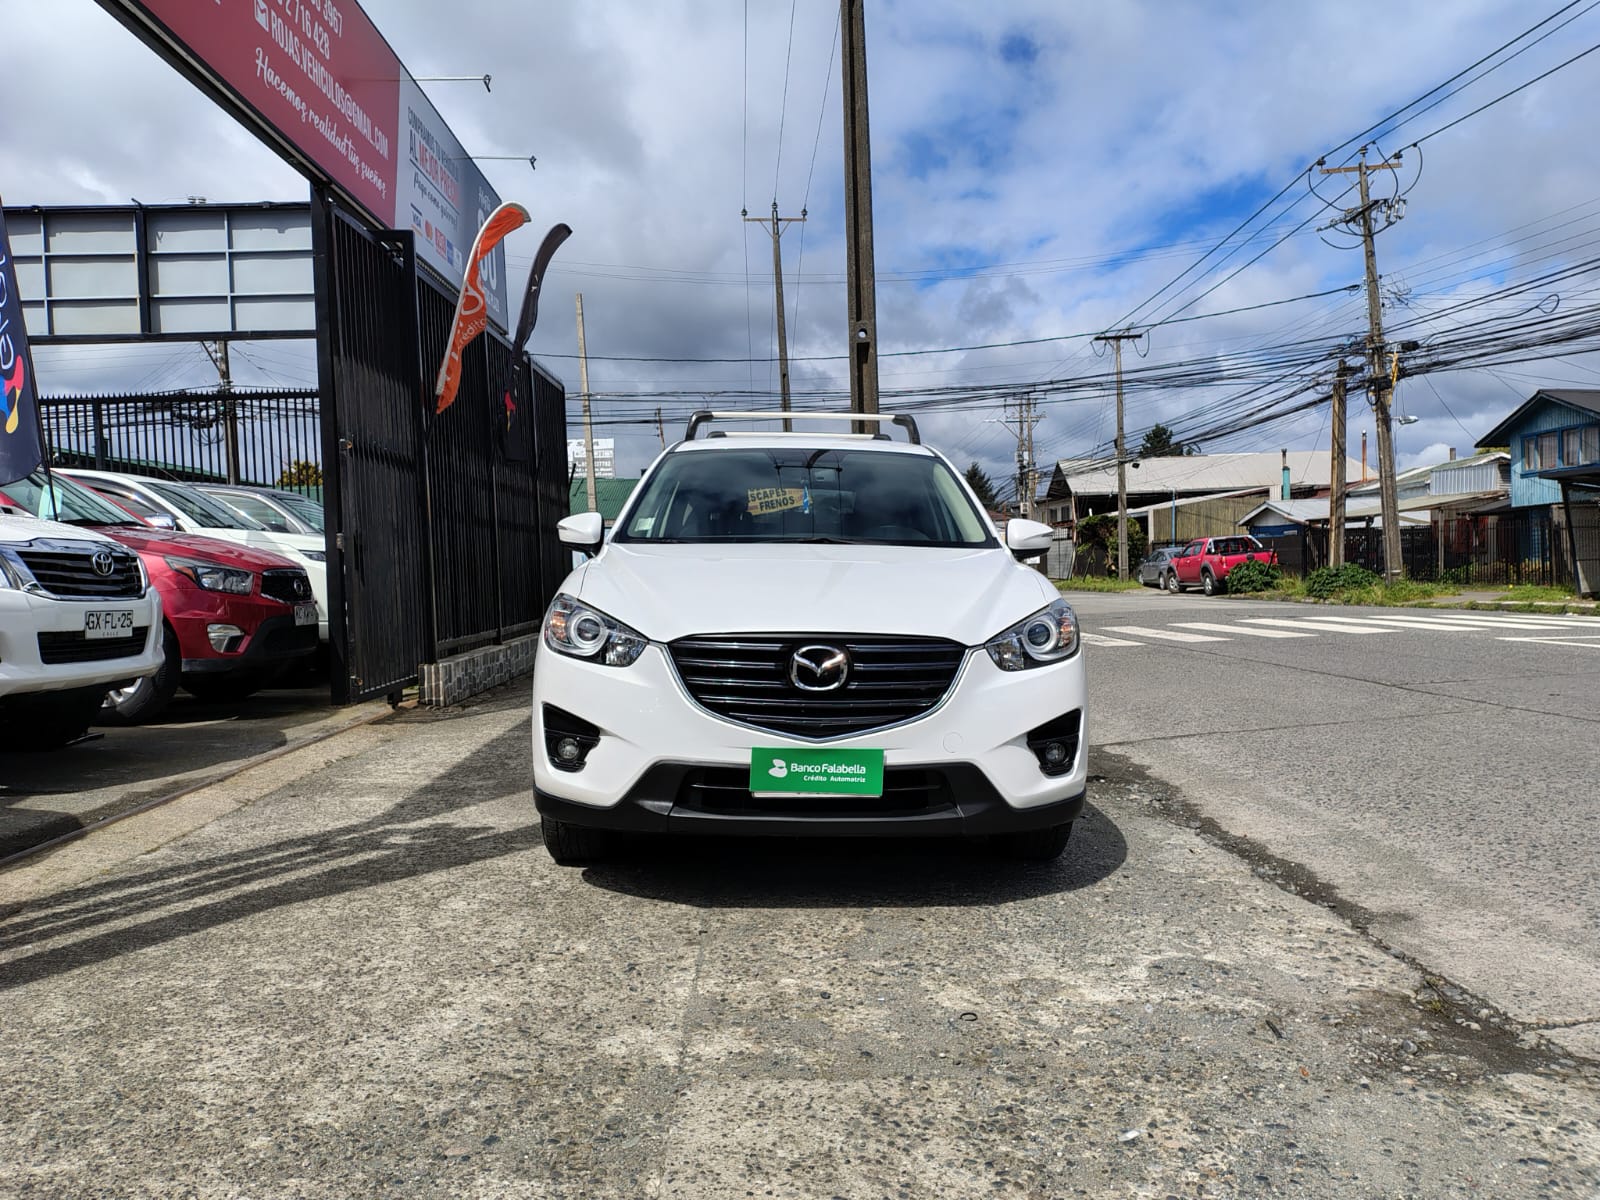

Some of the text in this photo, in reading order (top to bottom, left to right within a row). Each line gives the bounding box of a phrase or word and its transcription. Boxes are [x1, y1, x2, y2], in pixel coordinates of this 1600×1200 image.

[323, 0, 343, 38] 3967
[313, 21, 330, 60] 428
[271, 8, 389, 161] ROJAS.VEHICULOS@GMAIL.COM
[256, 47, 387, 200] Hacemos realidad tus sueños
[409, 128, 418, 162] AL
[759, 495, 795, 512] FRENOS
[790, 762, 866, 775] Banco Falabella
[803, 774, 827, 782] Crédito
